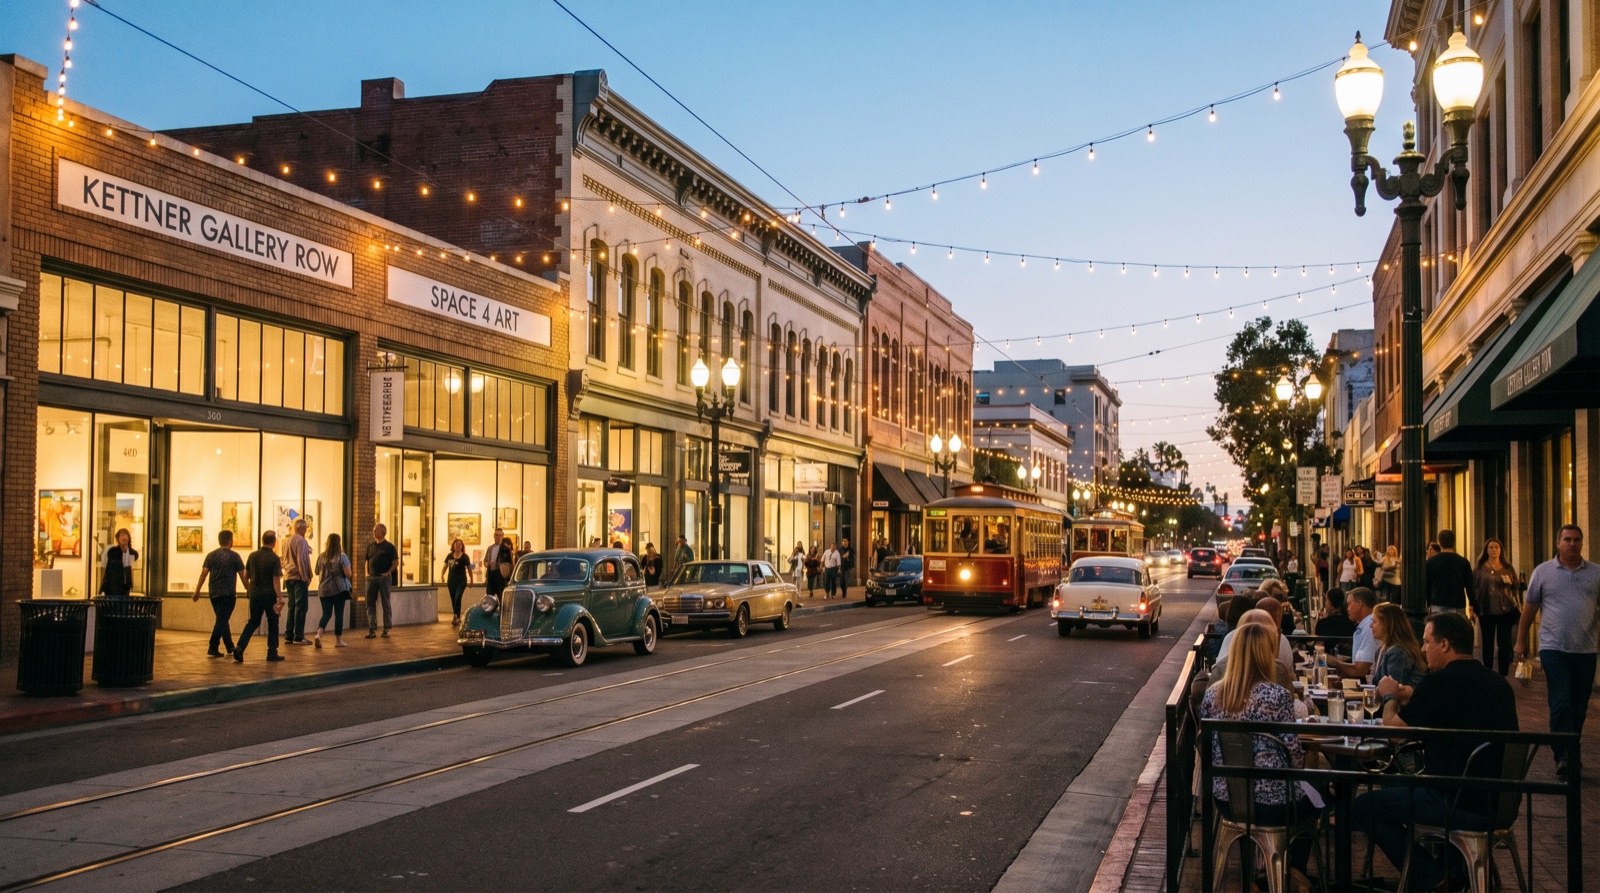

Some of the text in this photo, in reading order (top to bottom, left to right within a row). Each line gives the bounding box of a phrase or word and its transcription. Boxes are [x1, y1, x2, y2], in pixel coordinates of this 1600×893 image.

[83, 175, 340, 279] KETTNER GALLERY ROW
[431, 285, 520, 332] SPACE 4 ART
